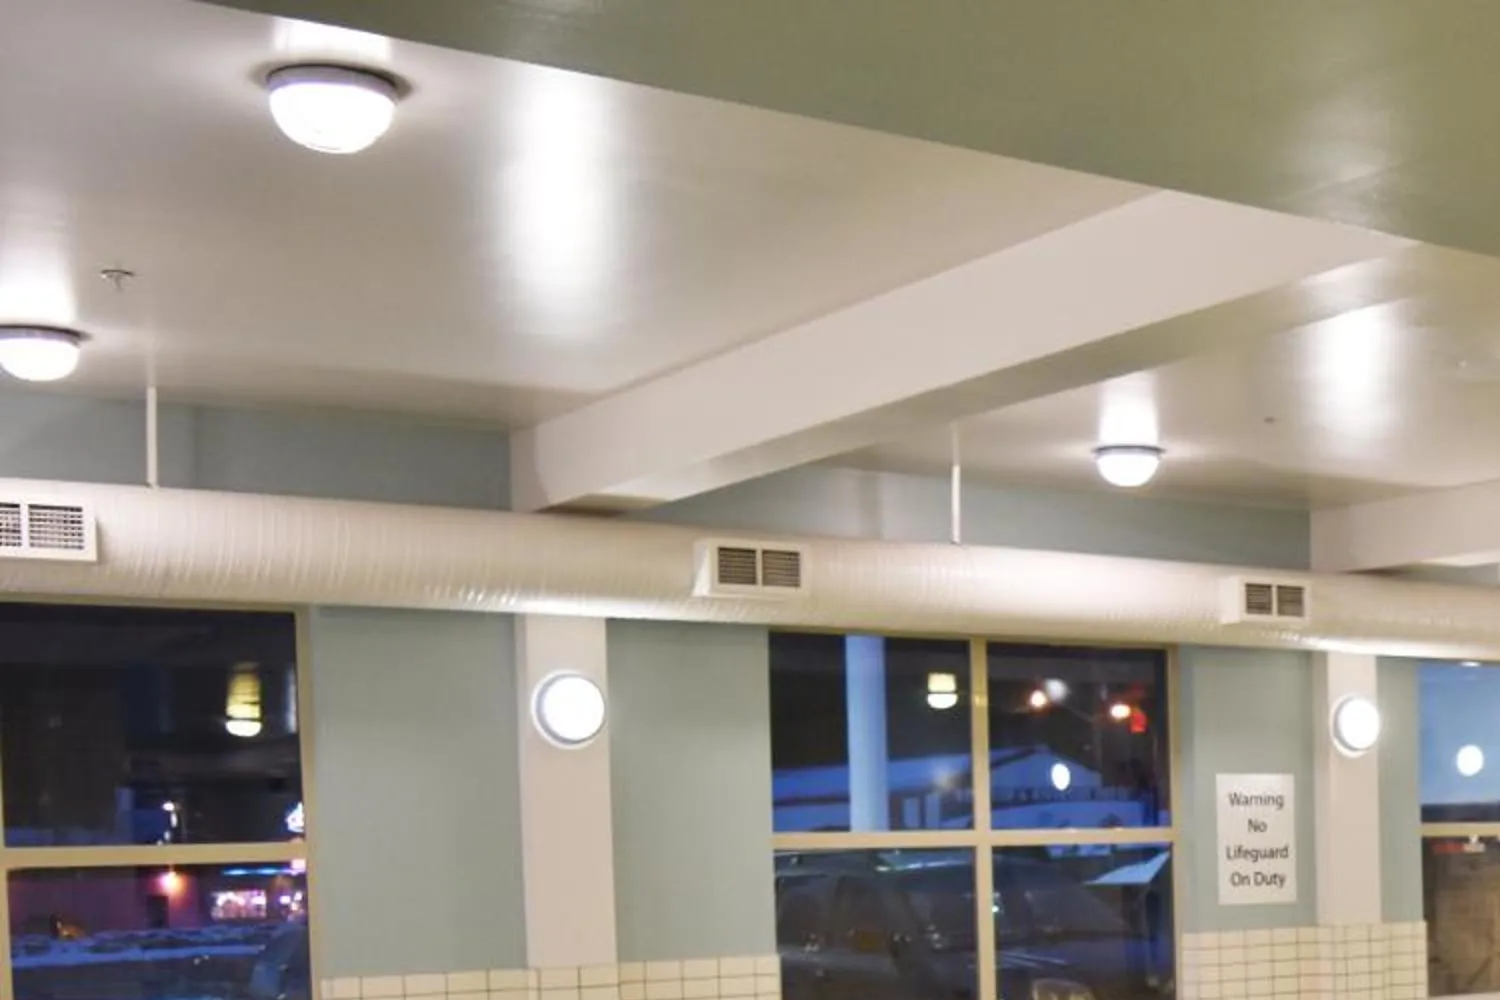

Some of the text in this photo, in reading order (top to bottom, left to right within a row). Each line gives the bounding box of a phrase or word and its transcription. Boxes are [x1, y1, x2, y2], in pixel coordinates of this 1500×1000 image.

[1228, 792, 1285, 810] Warning
[1247, 818, 1268, 832] No
[1226, 845, 1289, 862] Lifeguard
[1230, 871, 1285, 888] On Duty
